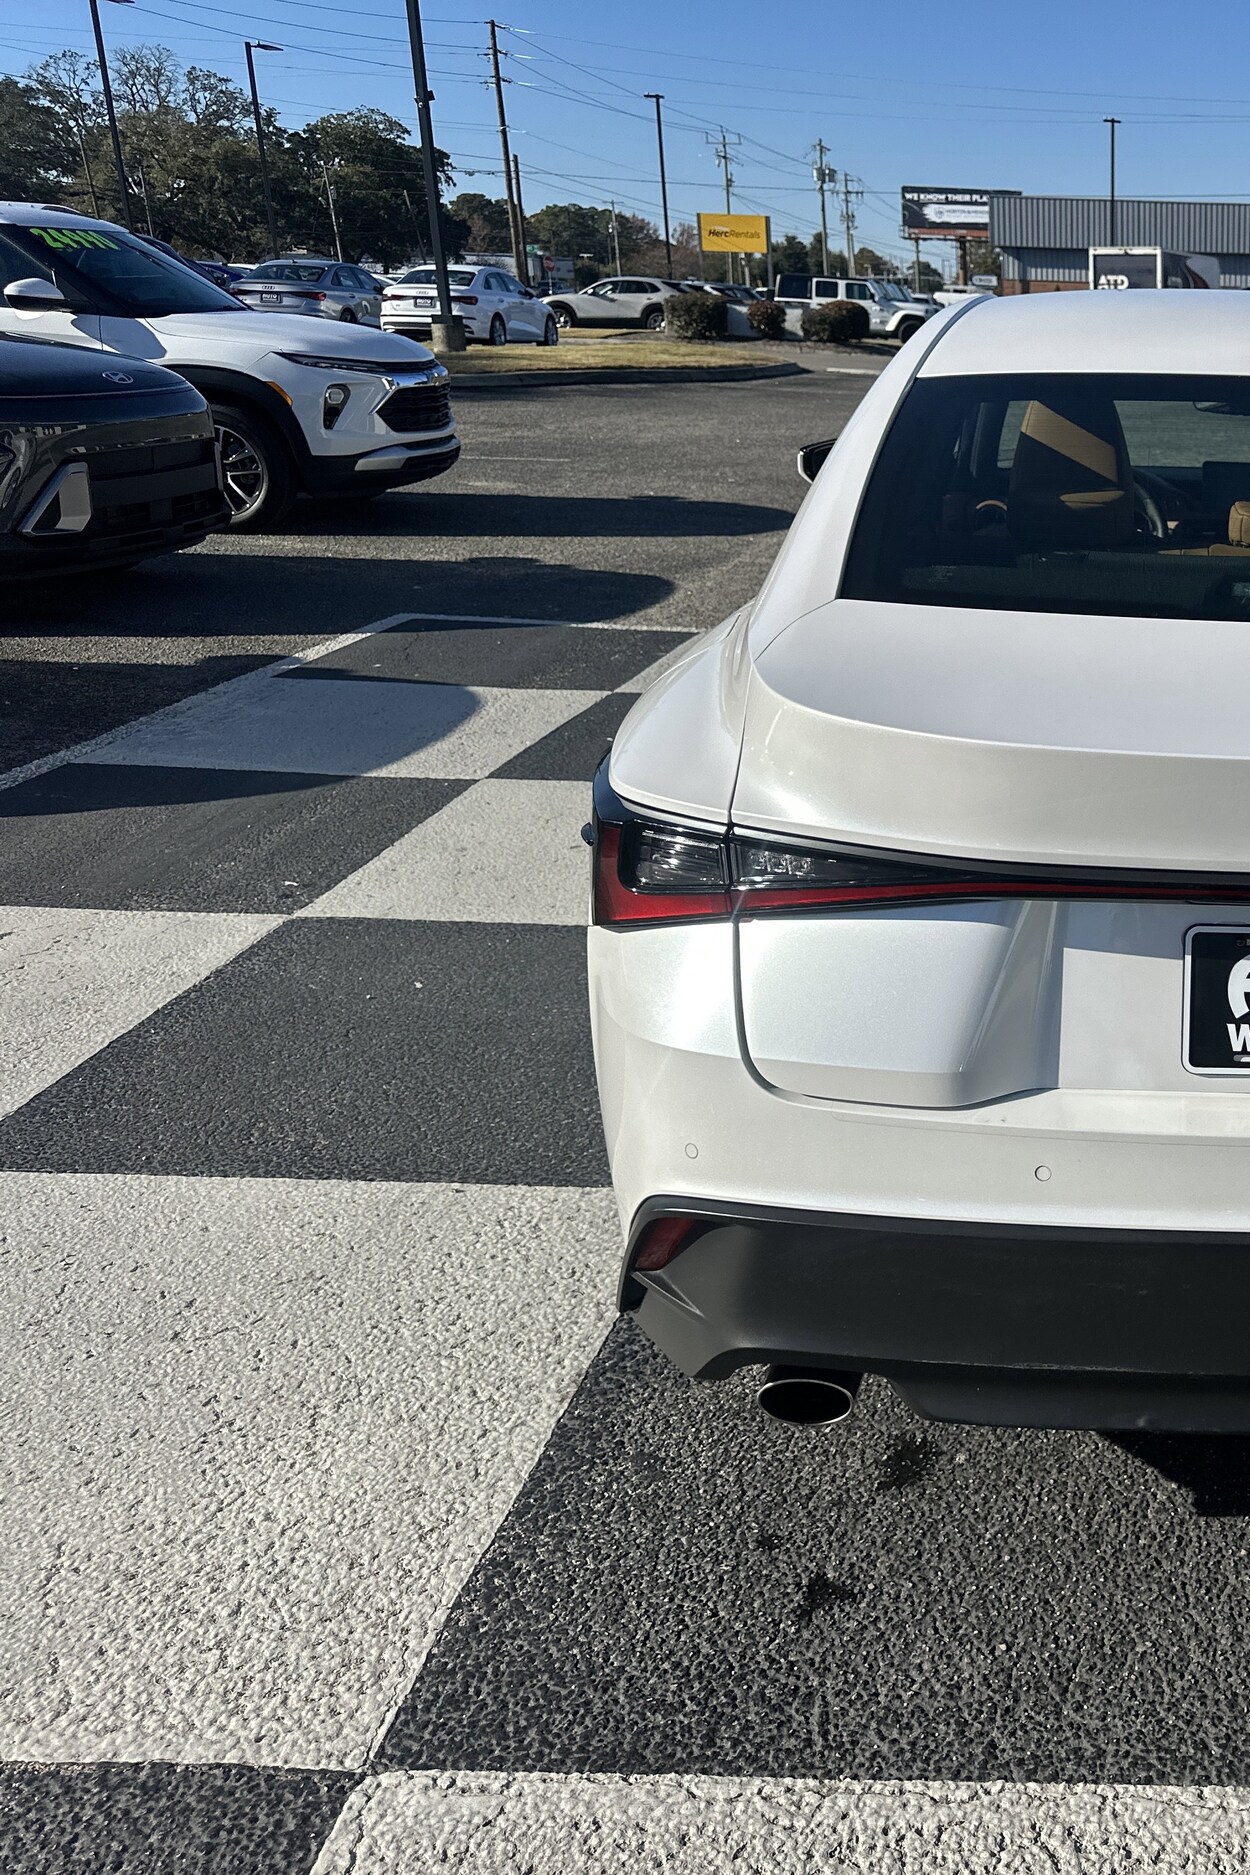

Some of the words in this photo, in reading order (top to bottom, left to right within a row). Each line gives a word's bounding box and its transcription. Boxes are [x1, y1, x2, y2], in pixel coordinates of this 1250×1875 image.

[904, 193, 918, 201] WE
[920, 193, 946, 201] KNOW
[947, 194, 971, 202] THEIR
[29, 228, 120, 250] 24990
